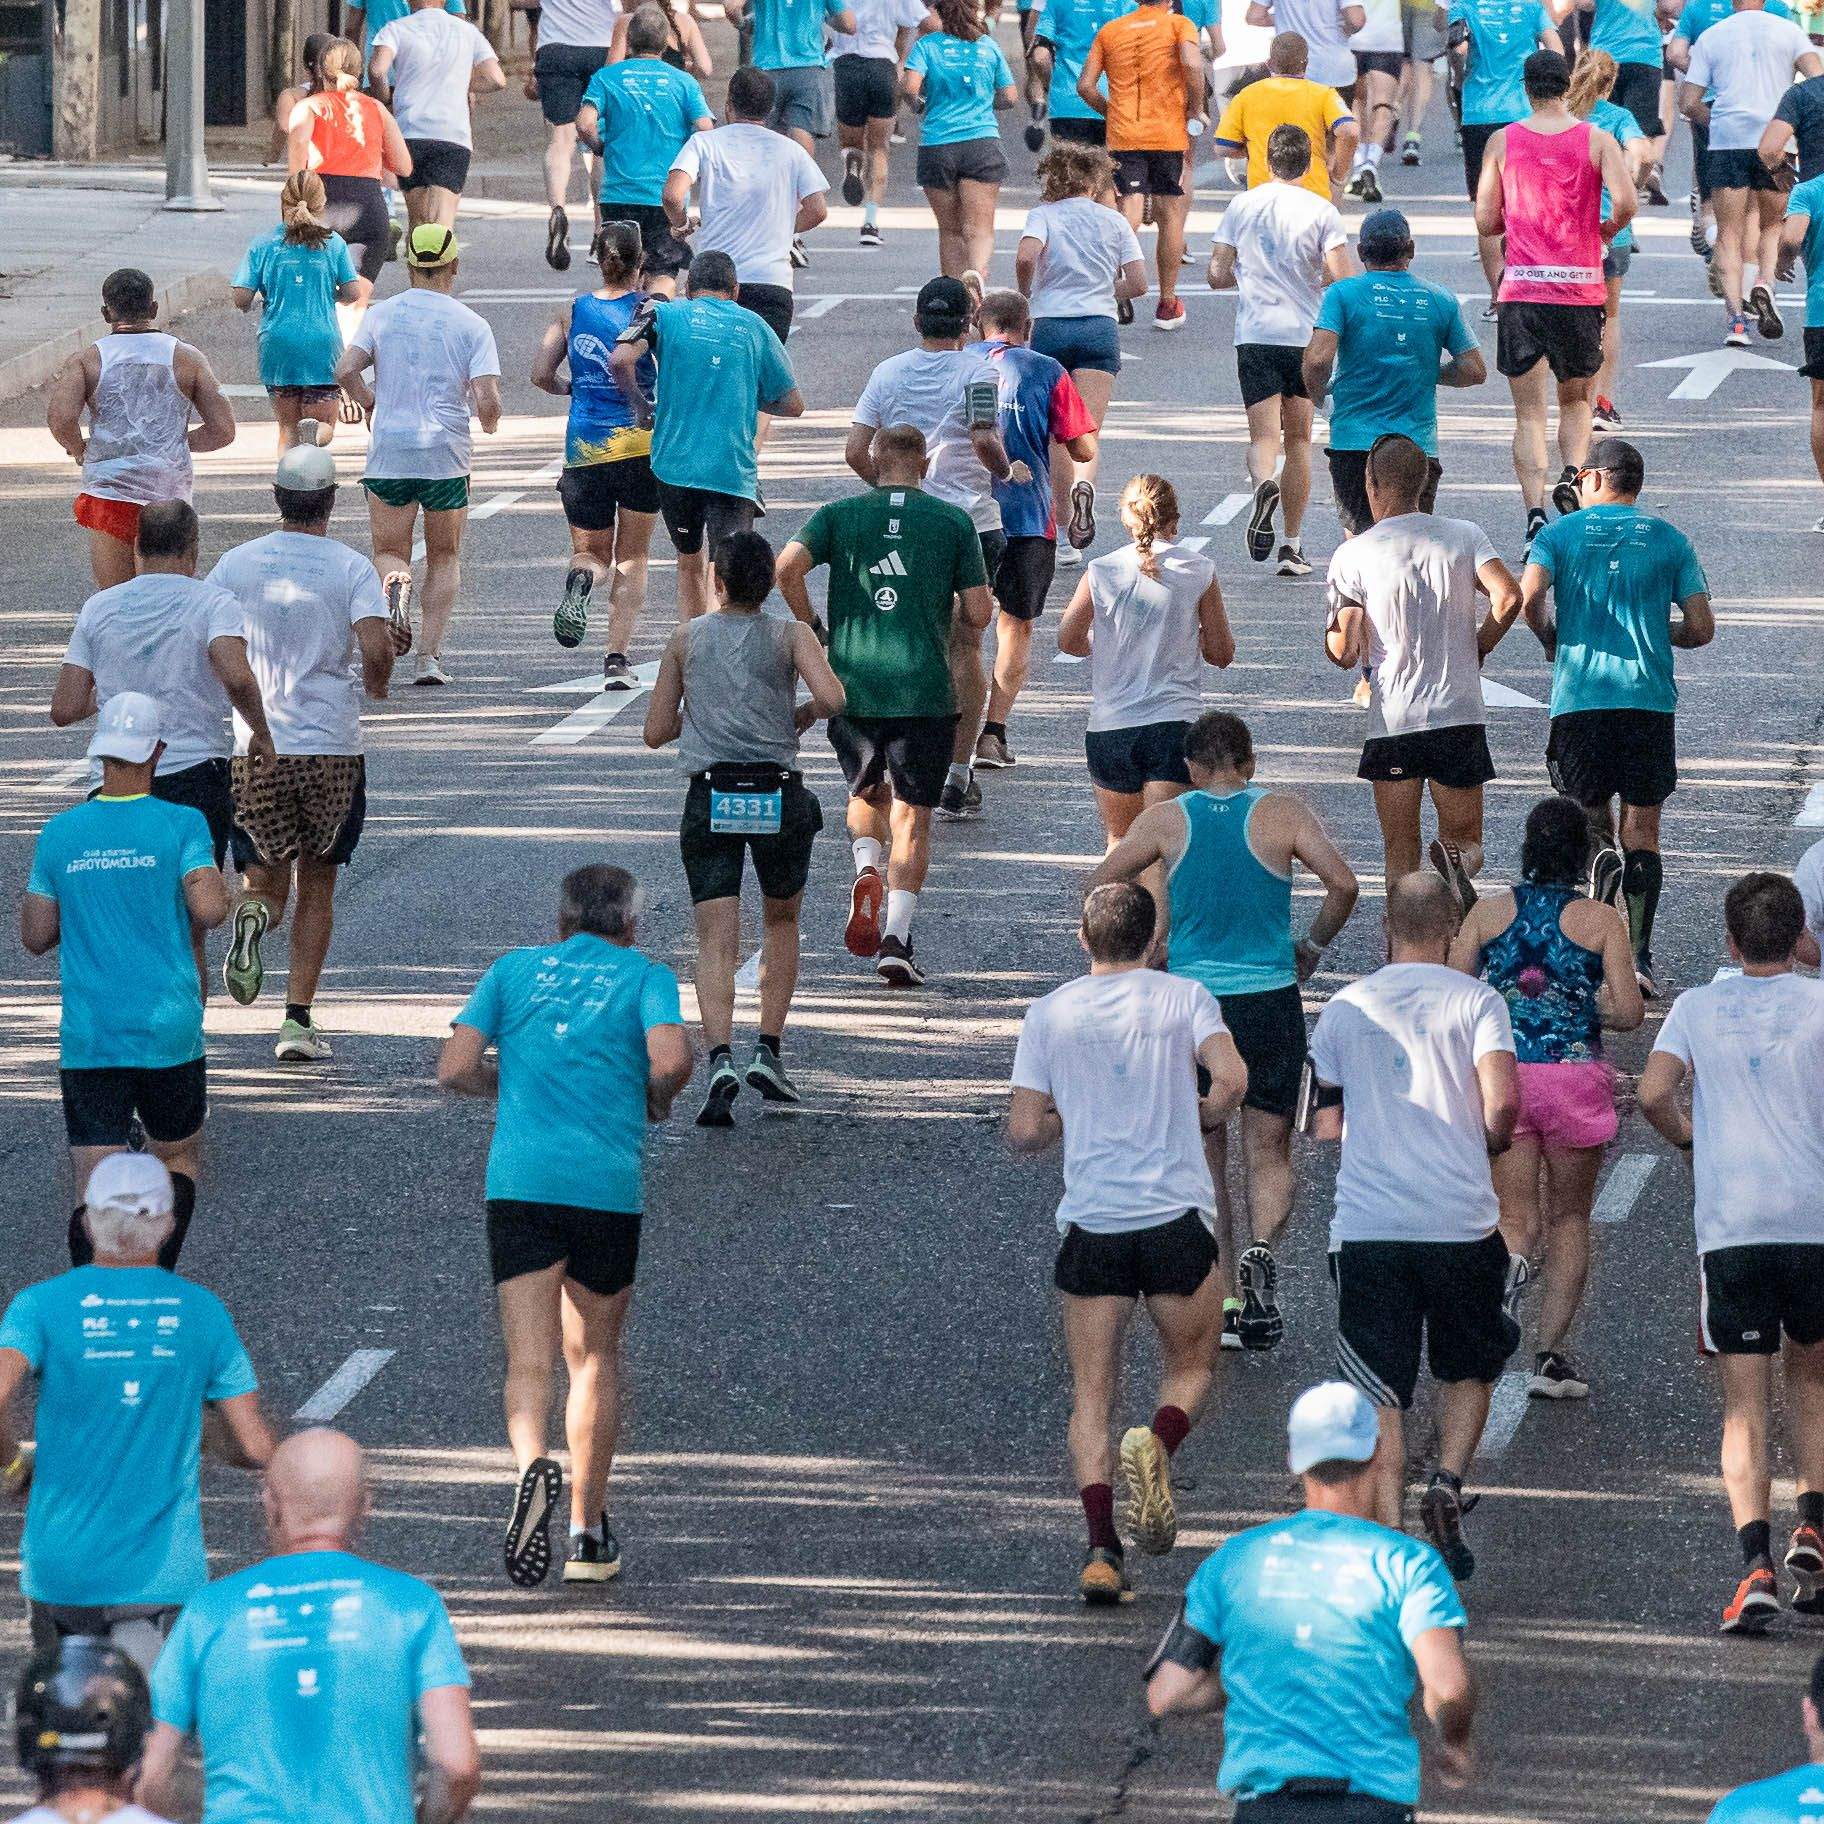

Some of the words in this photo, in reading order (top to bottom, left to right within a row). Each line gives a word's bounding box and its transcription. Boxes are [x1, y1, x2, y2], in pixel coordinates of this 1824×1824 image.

[1526, 270, 1545, 279] OUT
[1547, 271, 1567, 279] AND
[716, 796, 777, 817] 4331
